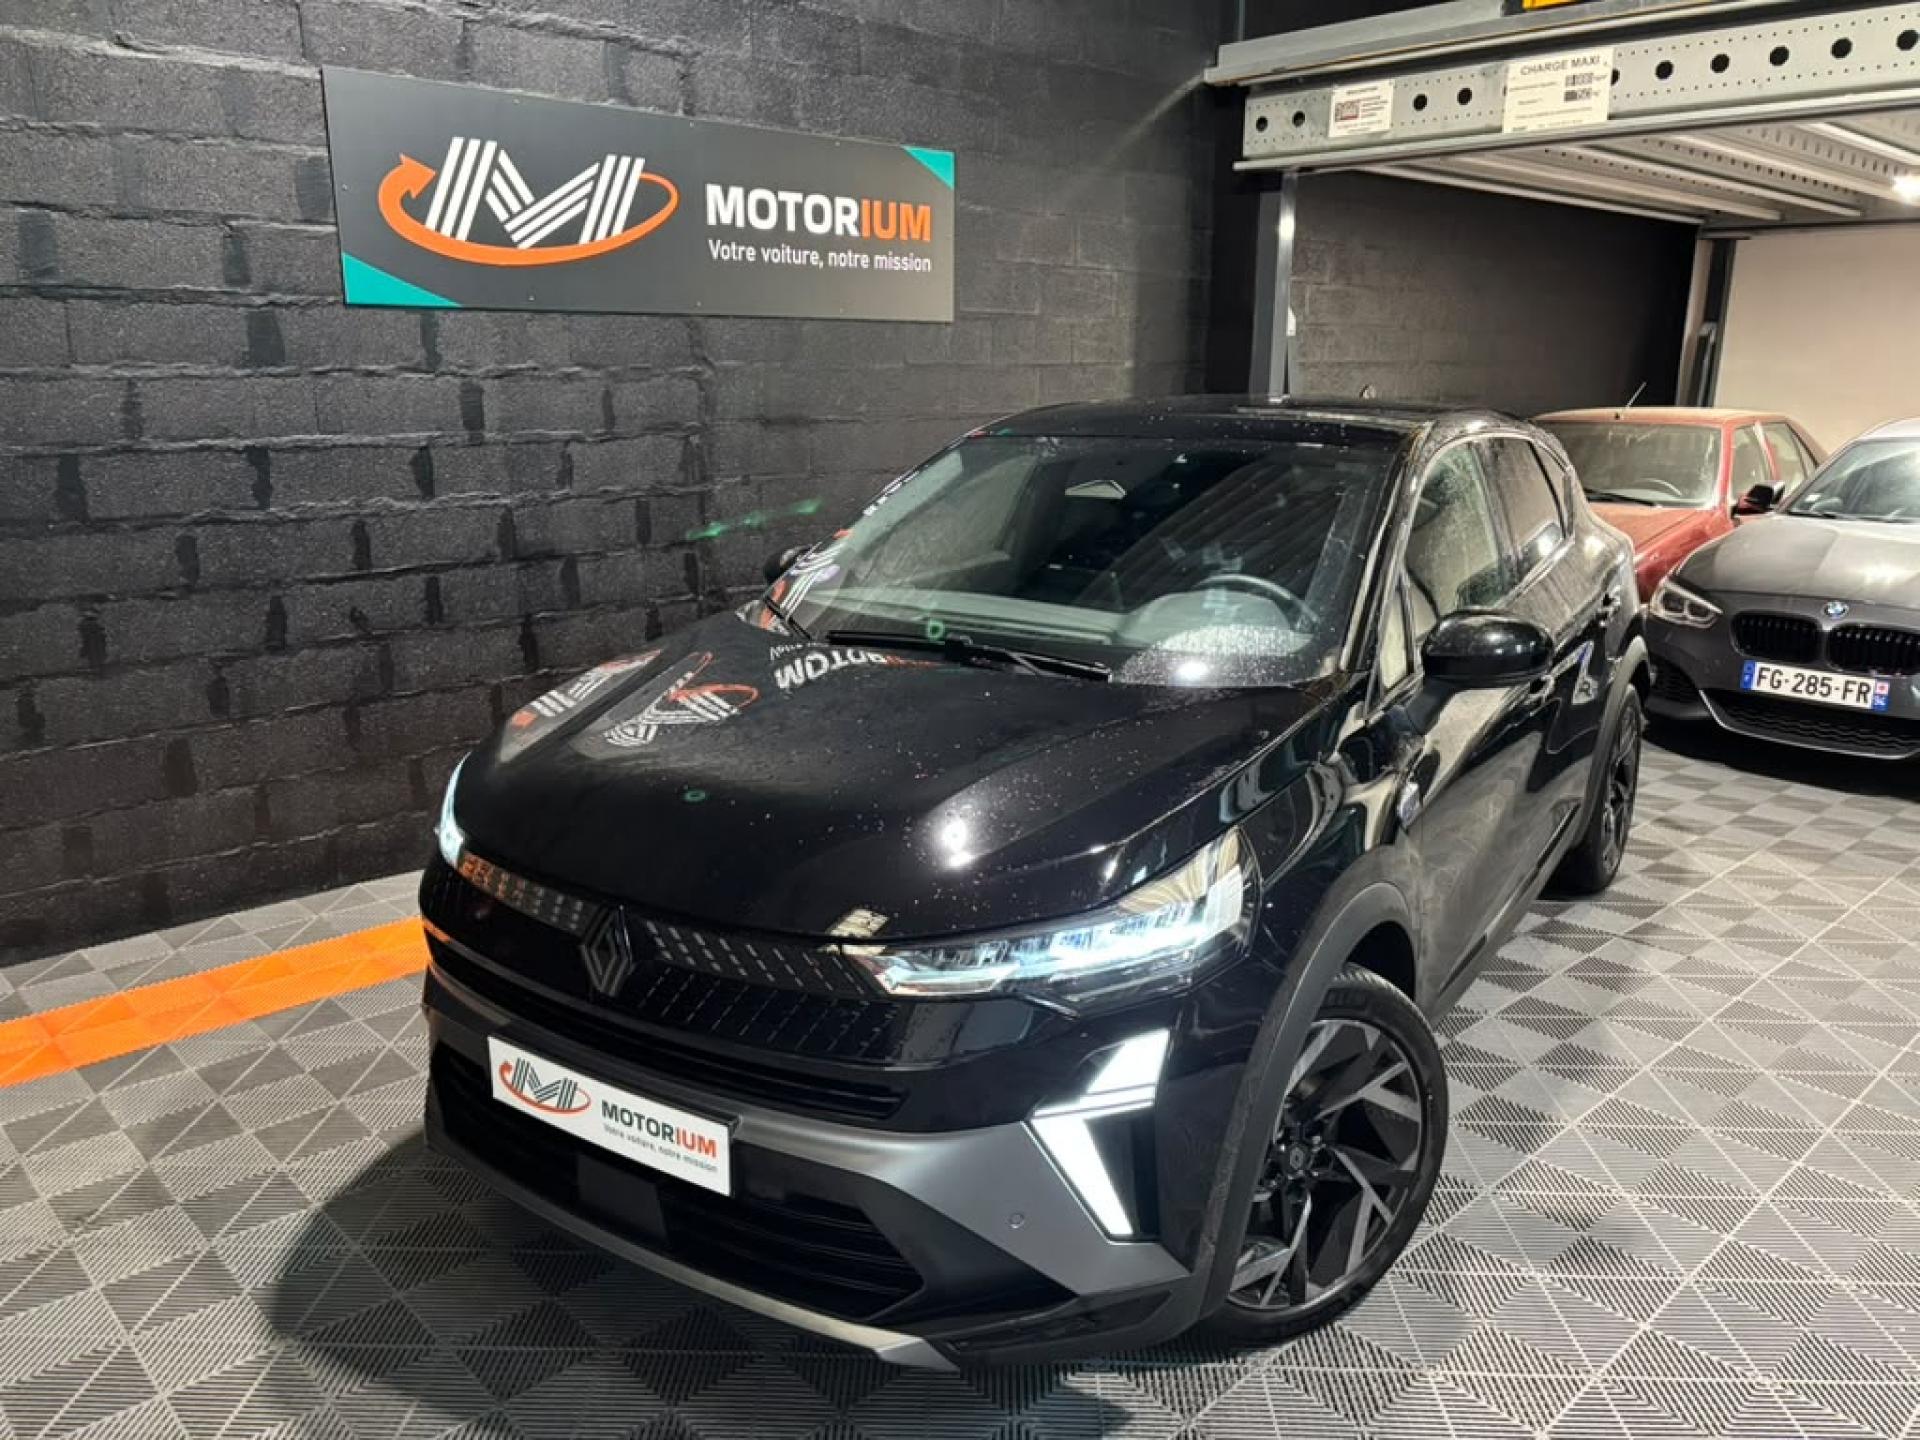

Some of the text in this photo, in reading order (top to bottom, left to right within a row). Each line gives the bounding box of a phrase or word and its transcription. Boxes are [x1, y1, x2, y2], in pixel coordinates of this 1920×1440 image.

[1520, 54, 1600, 76] CHARGE MAXI
[705, 183, 932, 243] MOTORIUM
[708, 239, 931, 273] Votre voiture, notre mission
[1756, 667, 1871, 704] FG-285-FR
[601, 1099, 717, 1158] MOTORIUM
